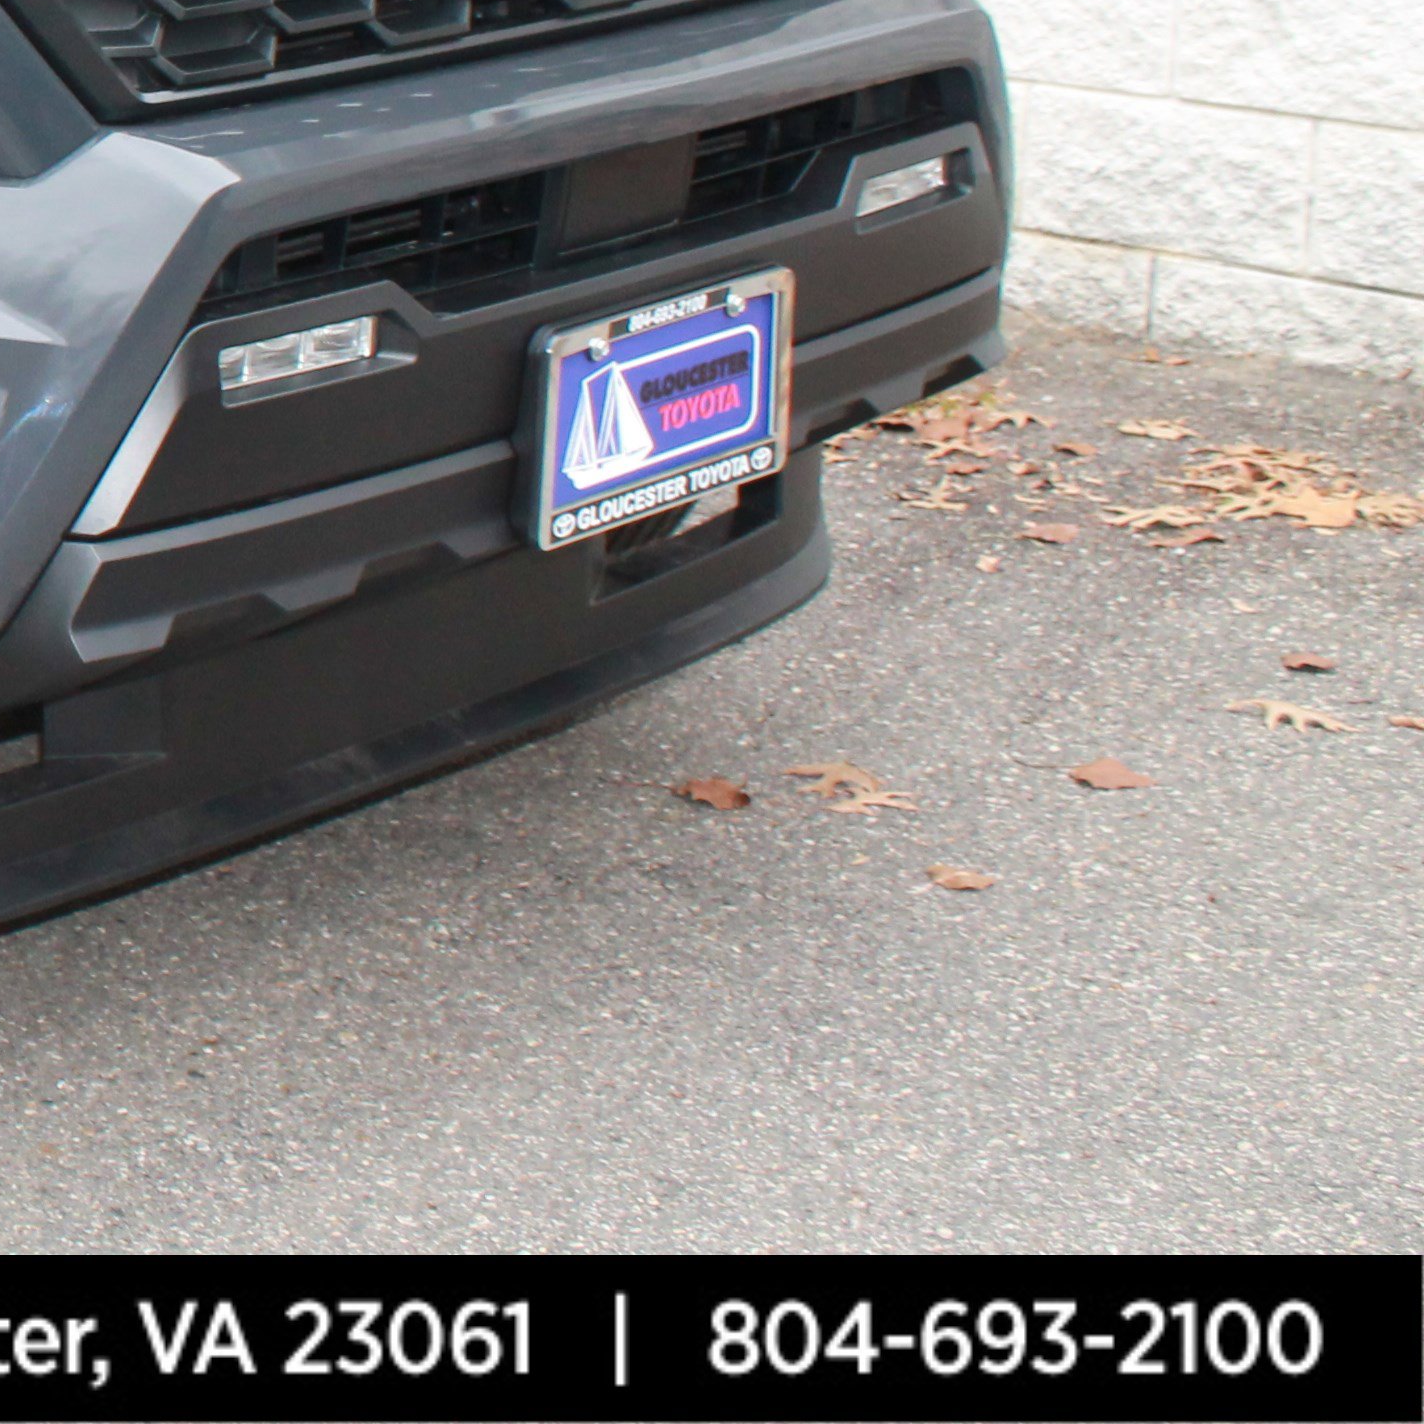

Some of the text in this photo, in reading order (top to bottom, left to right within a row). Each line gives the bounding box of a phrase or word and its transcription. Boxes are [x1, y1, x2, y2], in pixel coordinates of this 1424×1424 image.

[639, 350, 749, 403] GLOUCESTER
[658, 383, 740, 431] TOYOTA
[577, 454, 751, 530] GLOUCESTER TOYOTA
